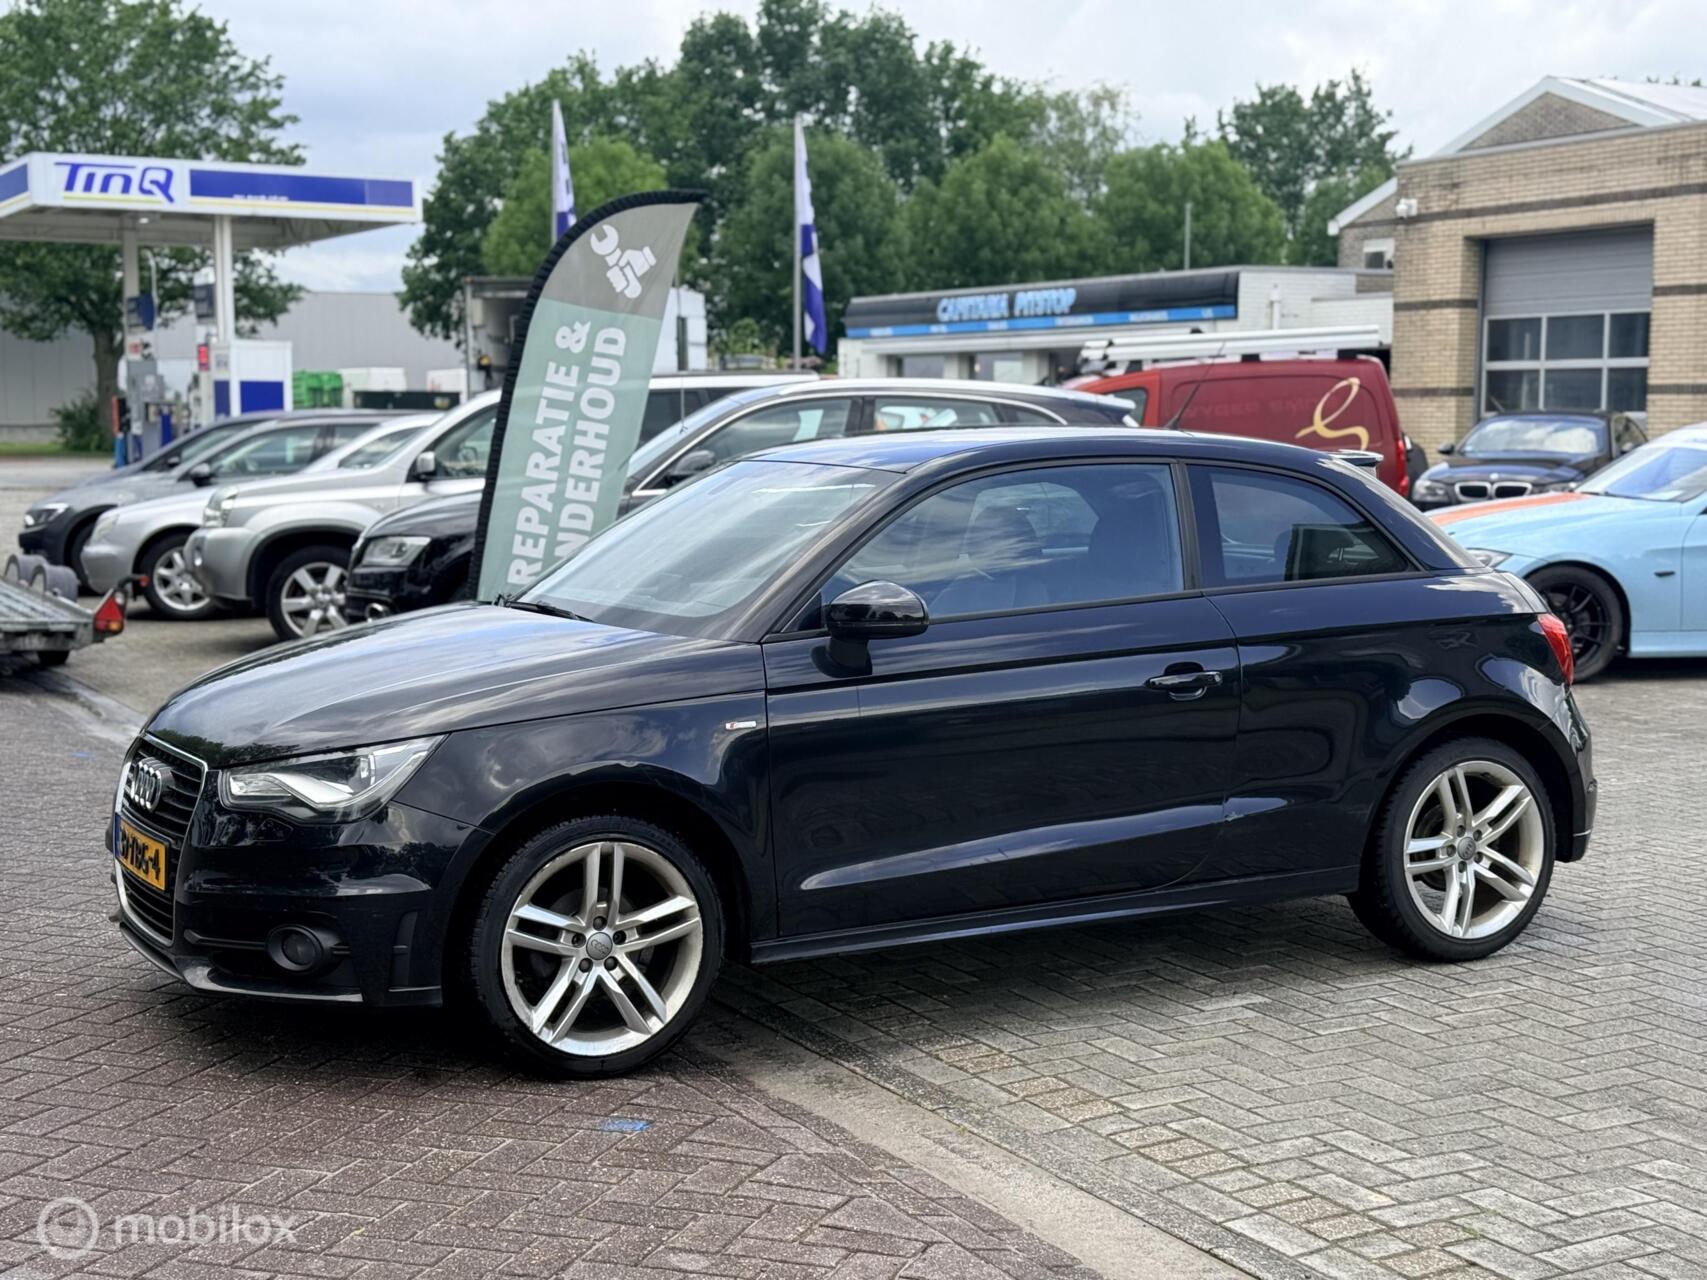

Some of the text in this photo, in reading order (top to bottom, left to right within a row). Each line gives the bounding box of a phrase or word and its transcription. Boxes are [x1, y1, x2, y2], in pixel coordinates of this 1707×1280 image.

[507, 321, 591, 585] REPARATIE &
[554, 327, 627, 558] NDERHOUD
